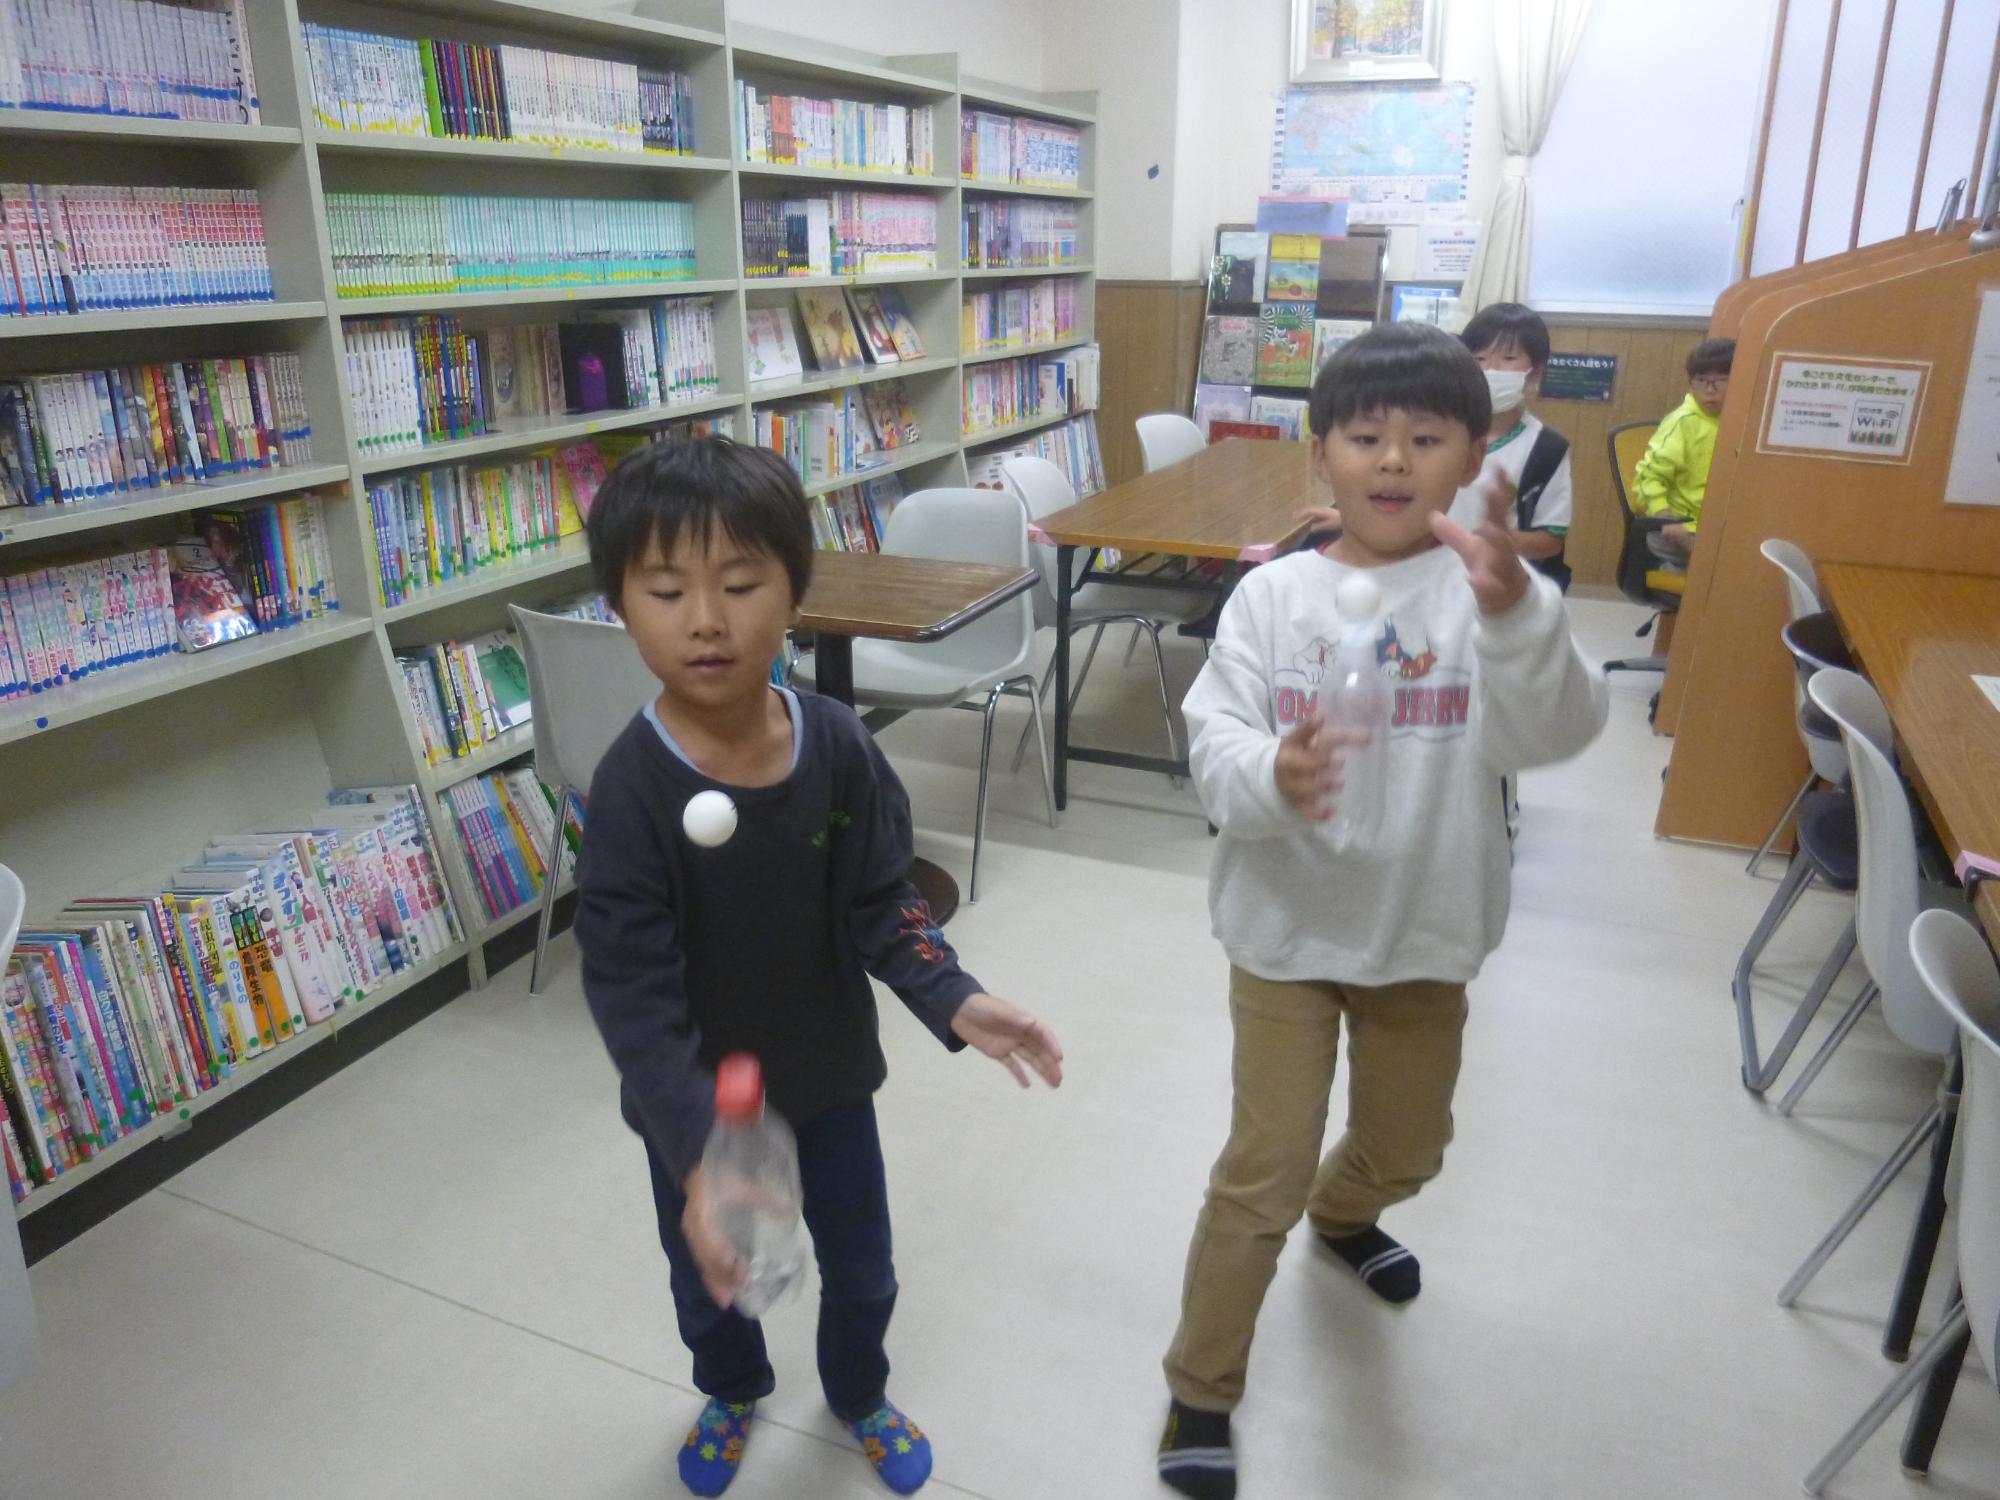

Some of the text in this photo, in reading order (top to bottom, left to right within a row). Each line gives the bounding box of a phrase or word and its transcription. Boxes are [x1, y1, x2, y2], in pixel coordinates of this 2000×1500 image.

[1857, 415, 1892, 429] Wi-Fi
[1275, 686, 1471, 728] OM JERRY
[228, 959, 249, 1005] のりもの
